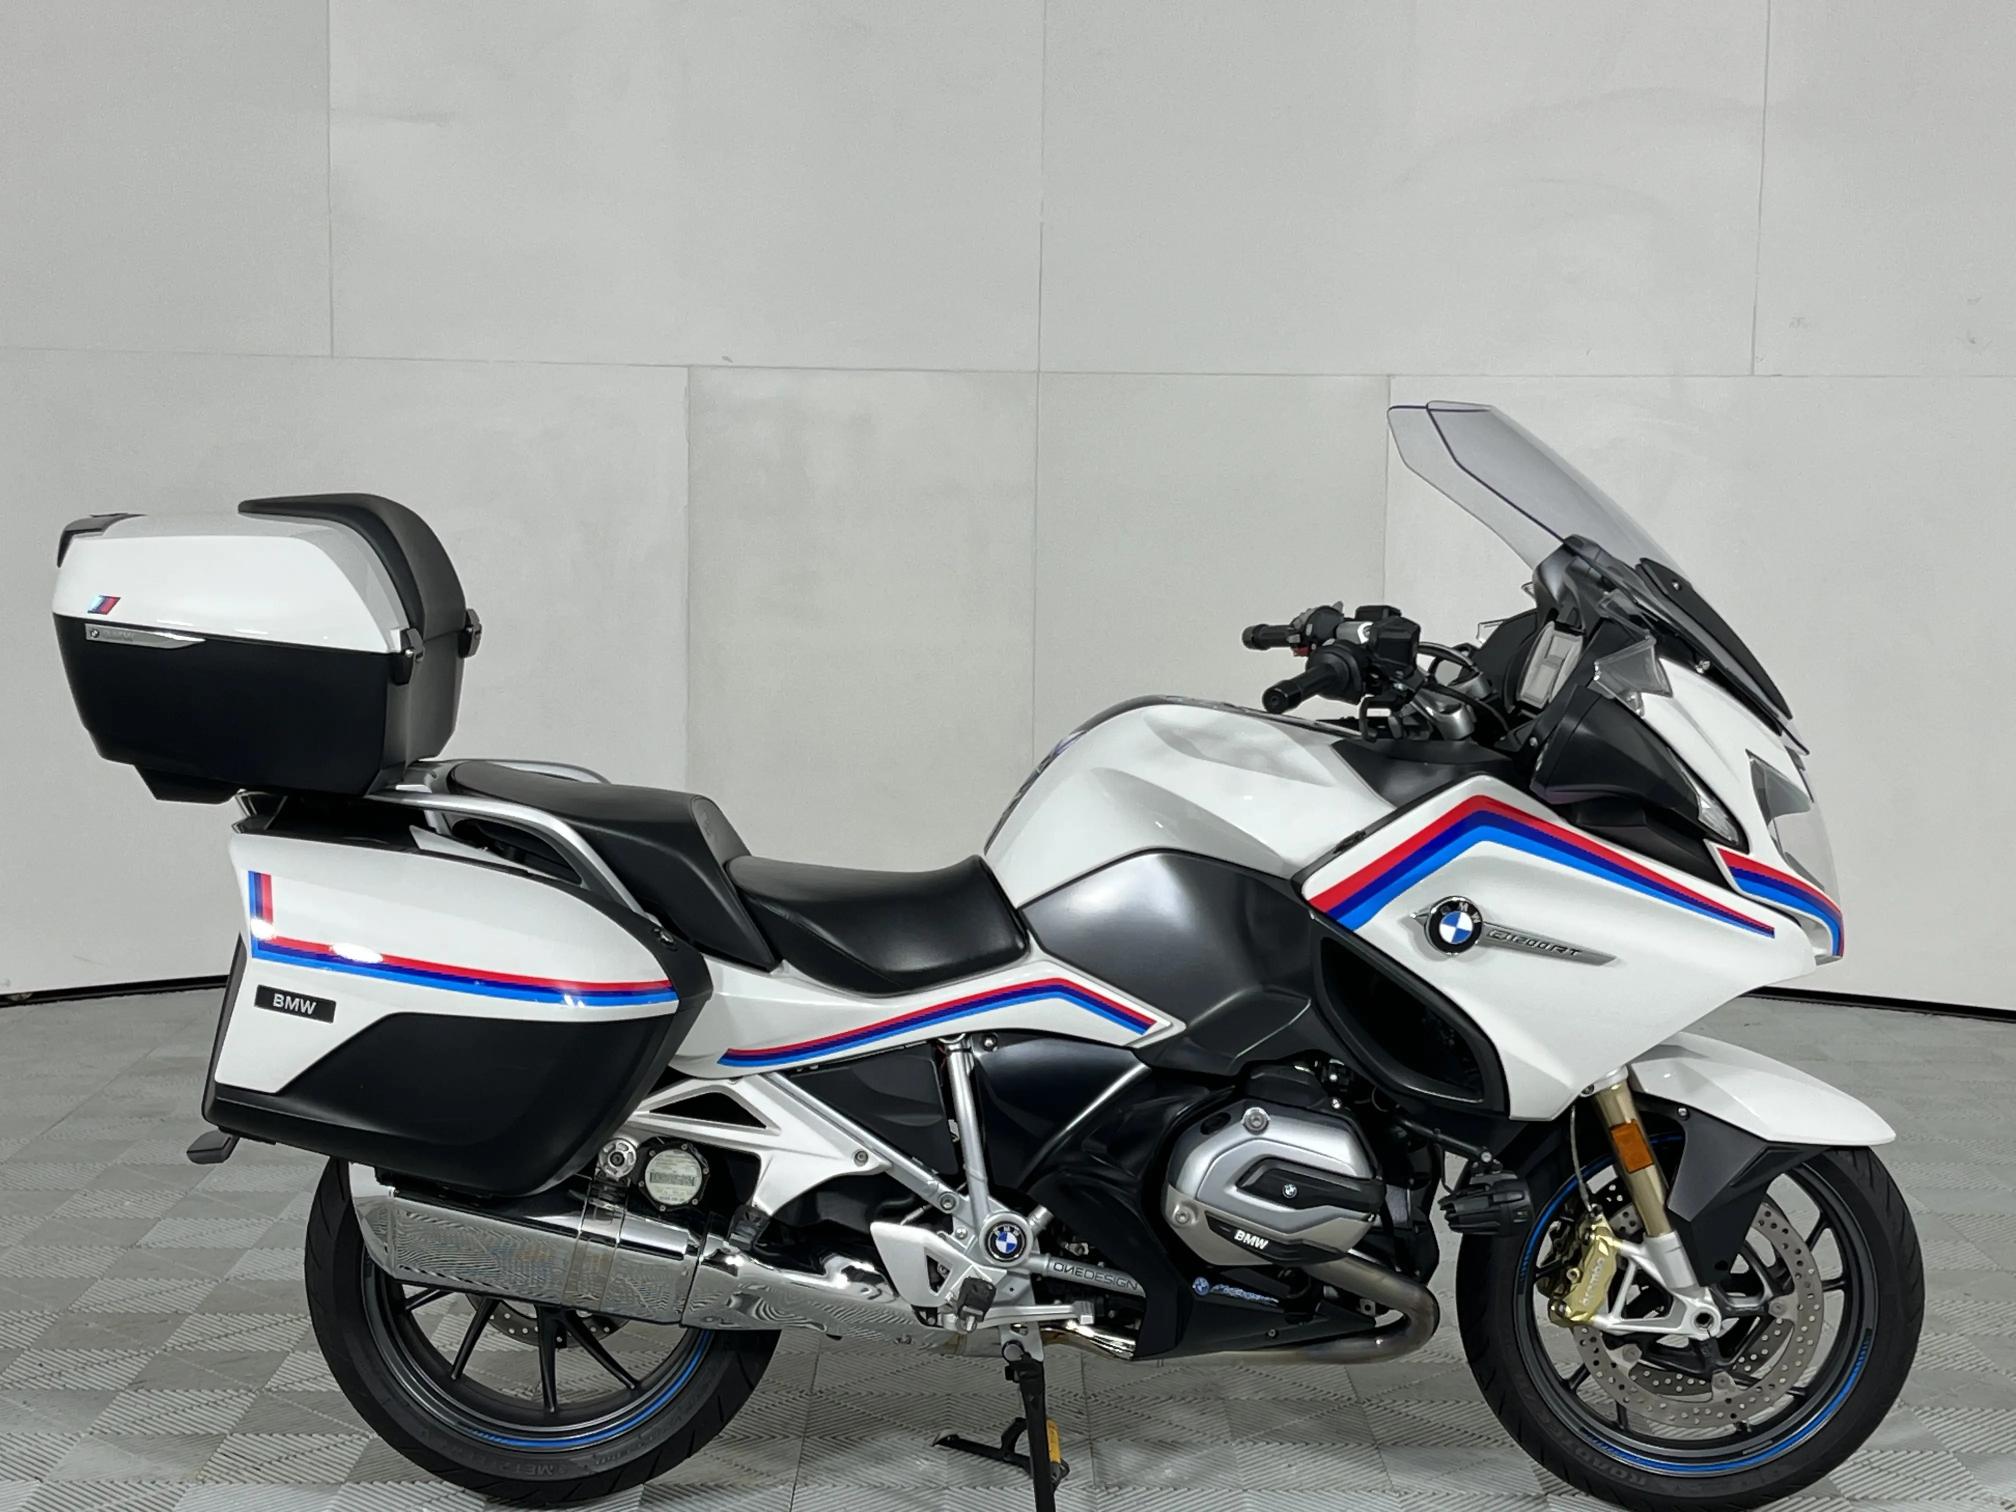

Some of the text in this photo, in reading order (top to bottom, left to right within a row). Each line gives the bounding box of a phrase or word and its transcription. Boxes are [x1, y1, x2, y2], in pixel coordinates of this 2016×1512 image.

[272, 993, 317, 1015] BMW
[1233, 1229, 1269, 1250] BMW
[1053, 1261, 1139, 1291] ONEDESIGN
